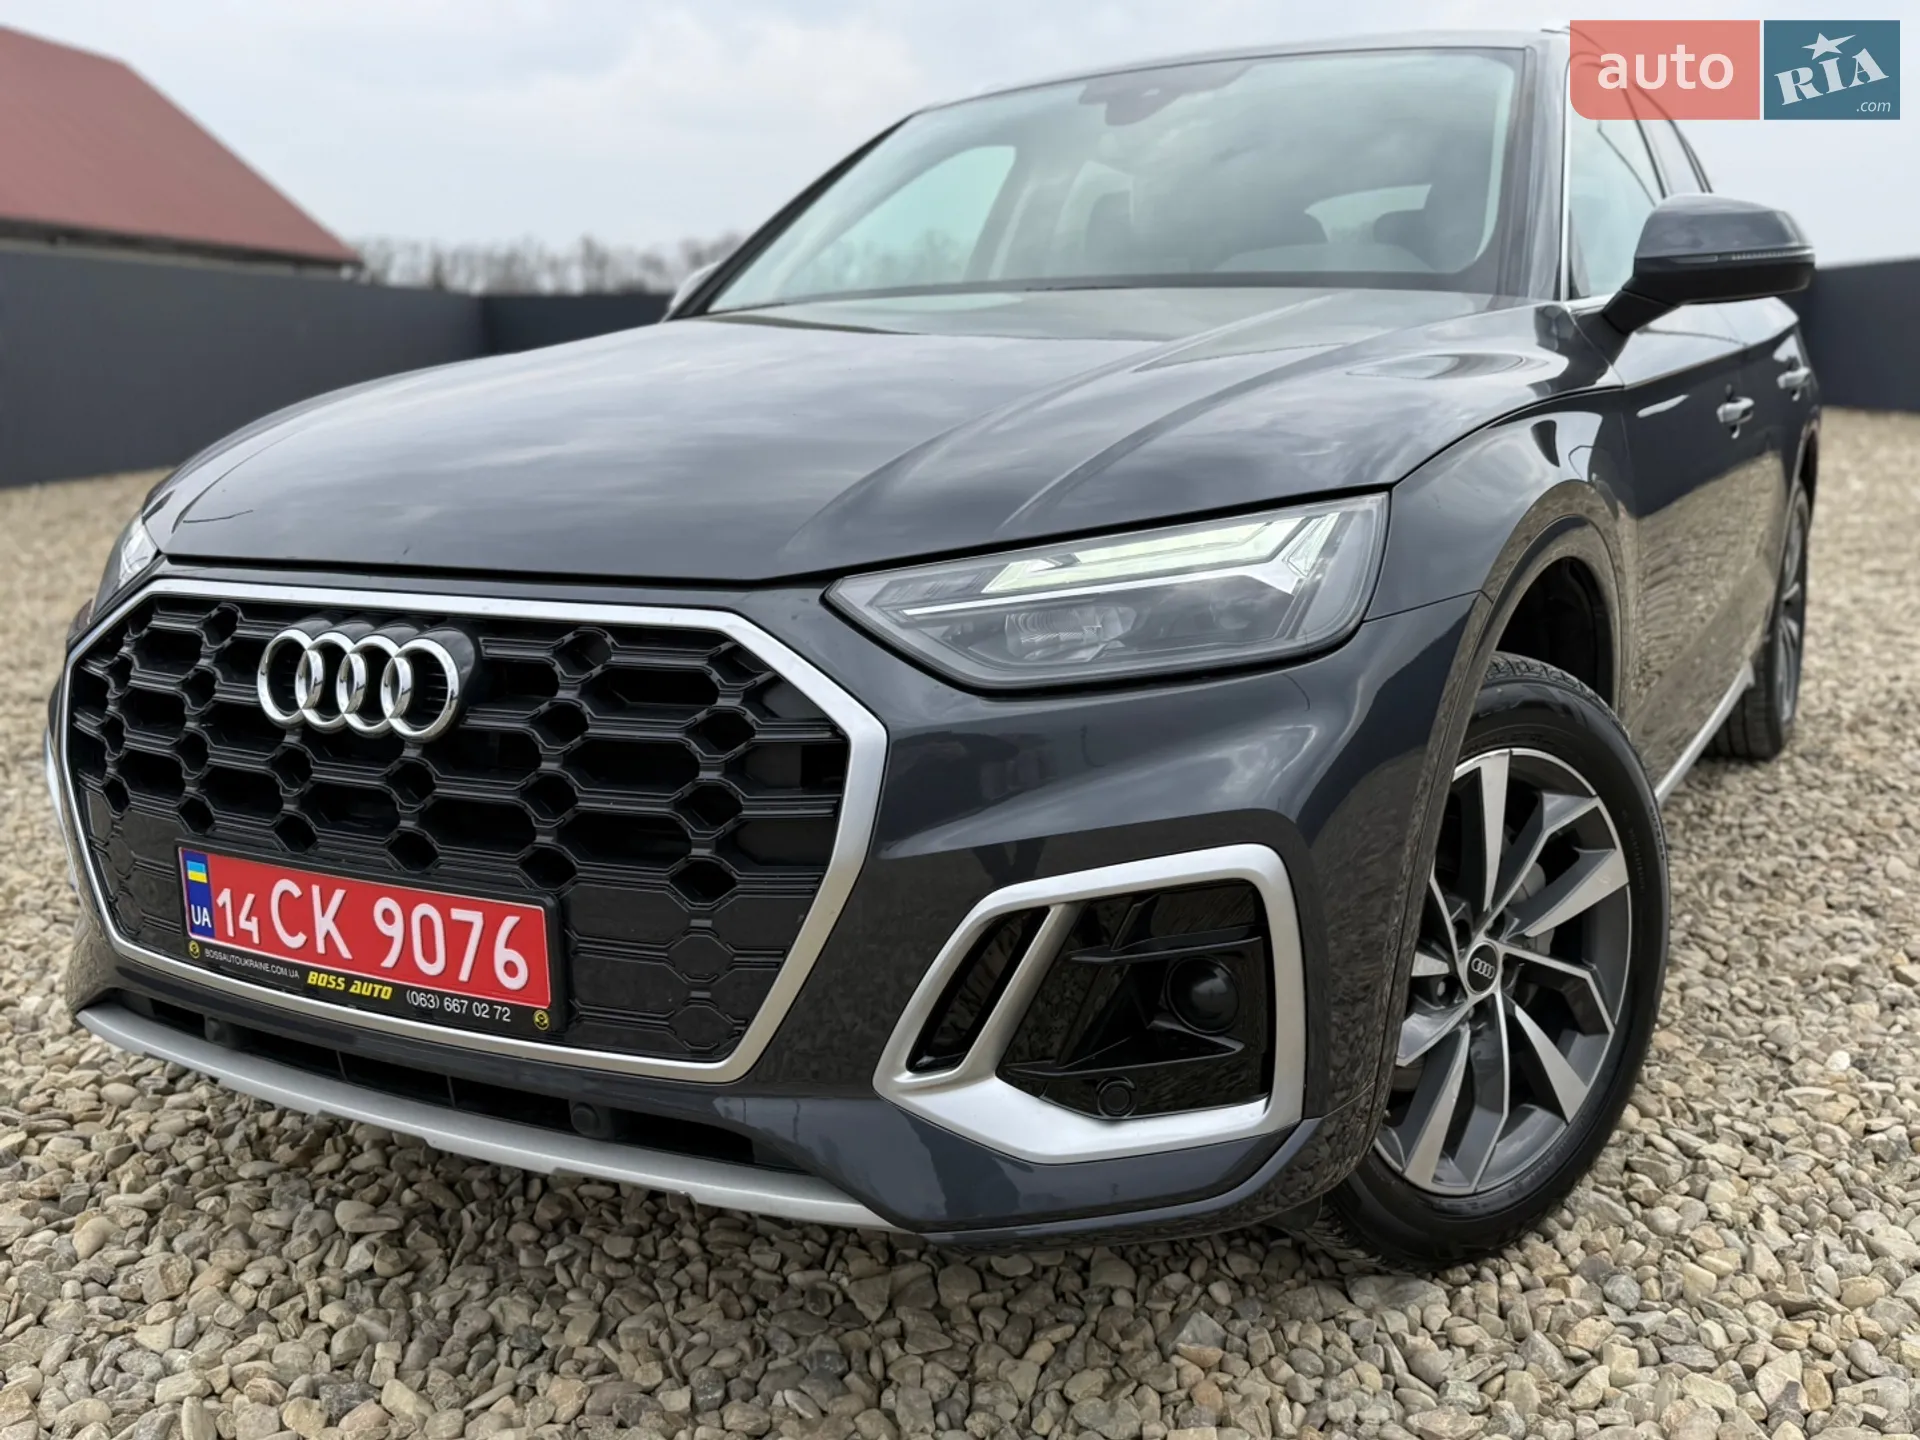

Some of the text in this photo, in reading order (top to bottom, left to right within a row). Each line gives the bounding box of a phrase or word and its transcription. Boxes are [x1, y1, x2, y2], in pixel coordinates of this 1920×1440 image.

[191, 905, 212, 929] UA
[372, 897, 530, 991] 9076
[205, 948, 300, 979] BOSSAUTOUKRAINE.COM.UA
[307, 971, 393, 1000] BOSS AUTO
[406, 989, 512, 1022] (063) 667 02 72
